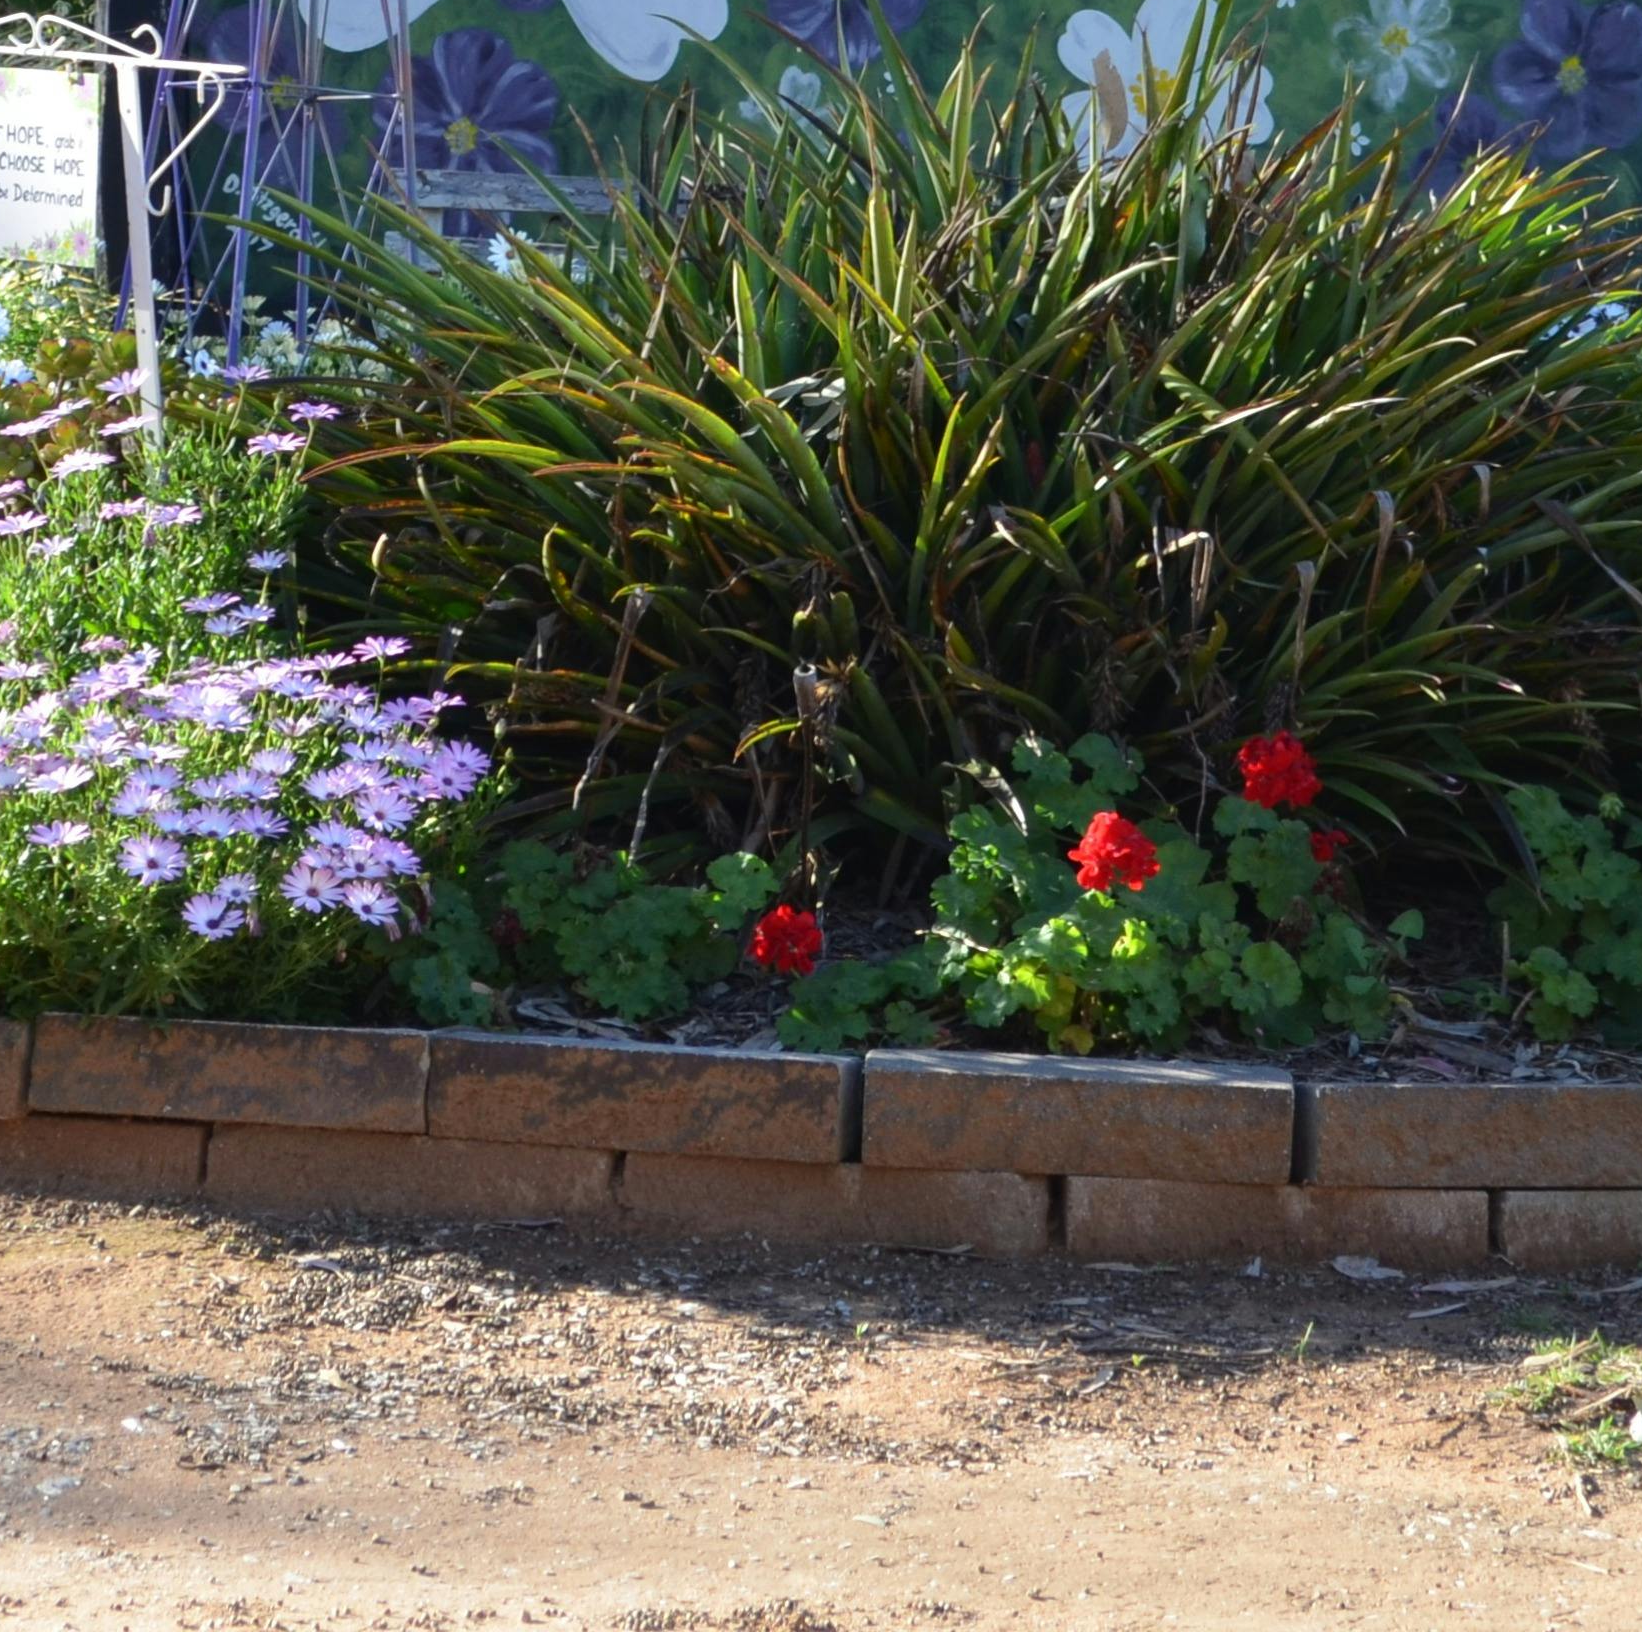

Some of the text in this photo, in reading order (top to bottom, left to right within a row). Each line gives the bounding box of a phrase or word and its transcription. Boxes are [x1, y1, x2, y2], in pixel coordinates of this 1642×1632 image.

[54, 133, 76, 152] grab
[54, 158, 85, 177] HOPE
[13, 183, 84, 207] Determined
